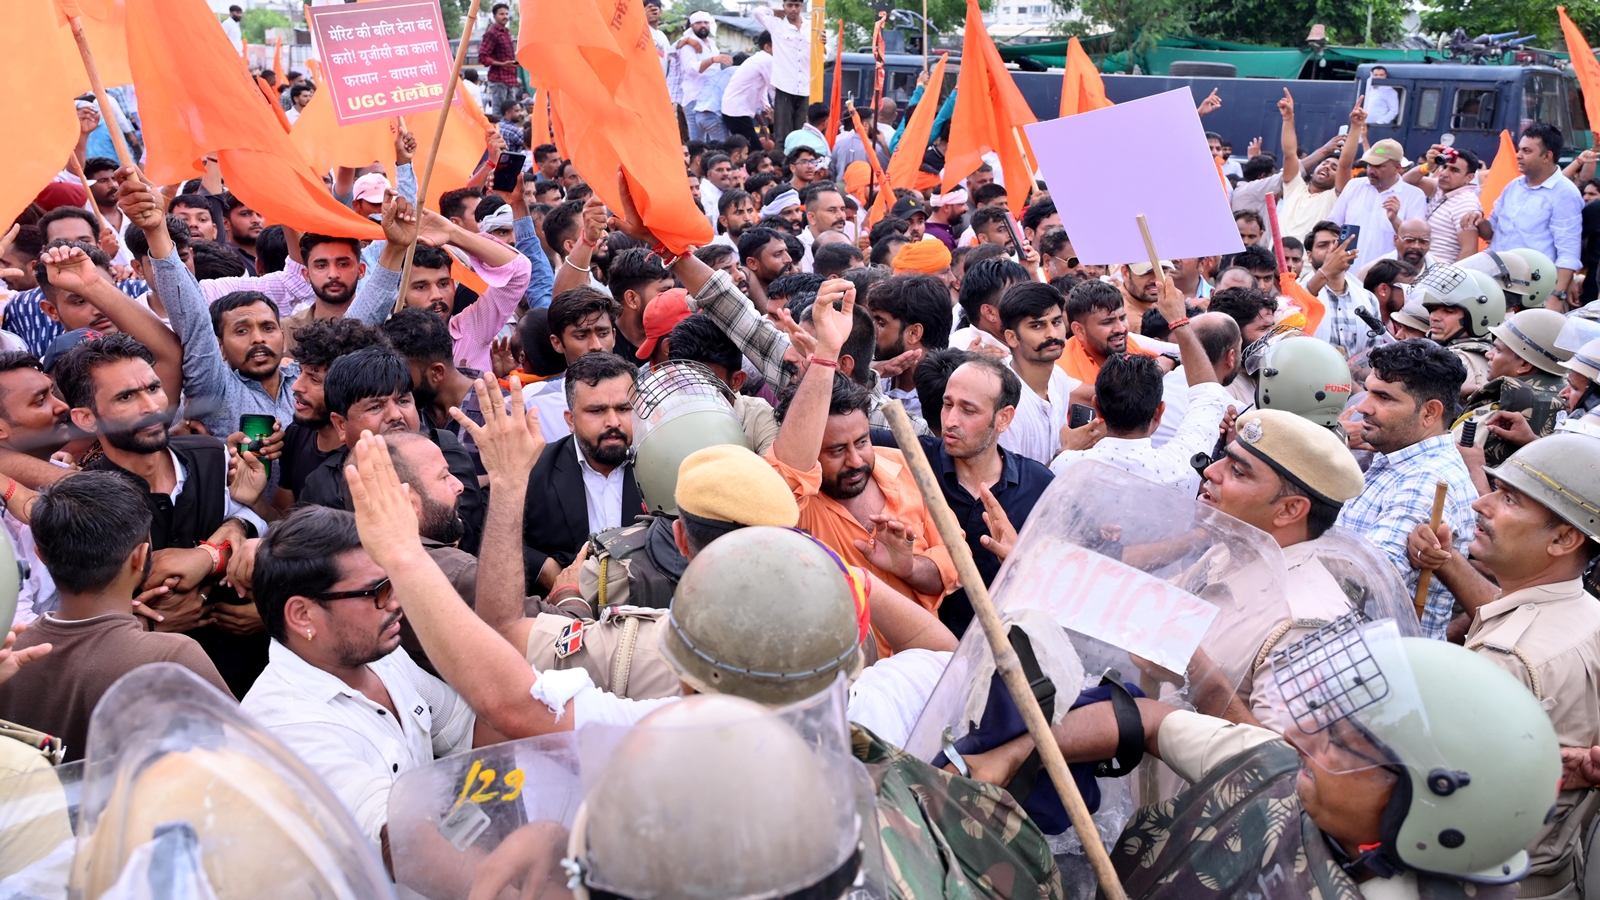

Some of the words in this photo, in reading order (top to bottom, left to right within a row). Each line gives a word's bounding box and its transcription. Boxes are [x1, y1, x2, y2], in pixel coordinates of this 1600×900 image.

[328, 25, 354, 42] मेरिट
[355, 22, 371, 39] की
[372, 20, 394, 36] बलि
[396, 18, 415, 34] देना
[416, 16, 434, 32] बंद
[330, 48, 357, 66] करो!
[358, 43, 393, 66] यूजीसी
[393, 45, 409, 57] का
[410, 40, 439, 54] काला
[342, 71, 379, 88] फरमान
[388, 66, 419, 81] वापस
[418, 60, 438, 76] लो!
[347, 93, 387, 111] UGC
[390, 81, 444, 104] रोलबैक
[450, 758, 525, 814] 129
